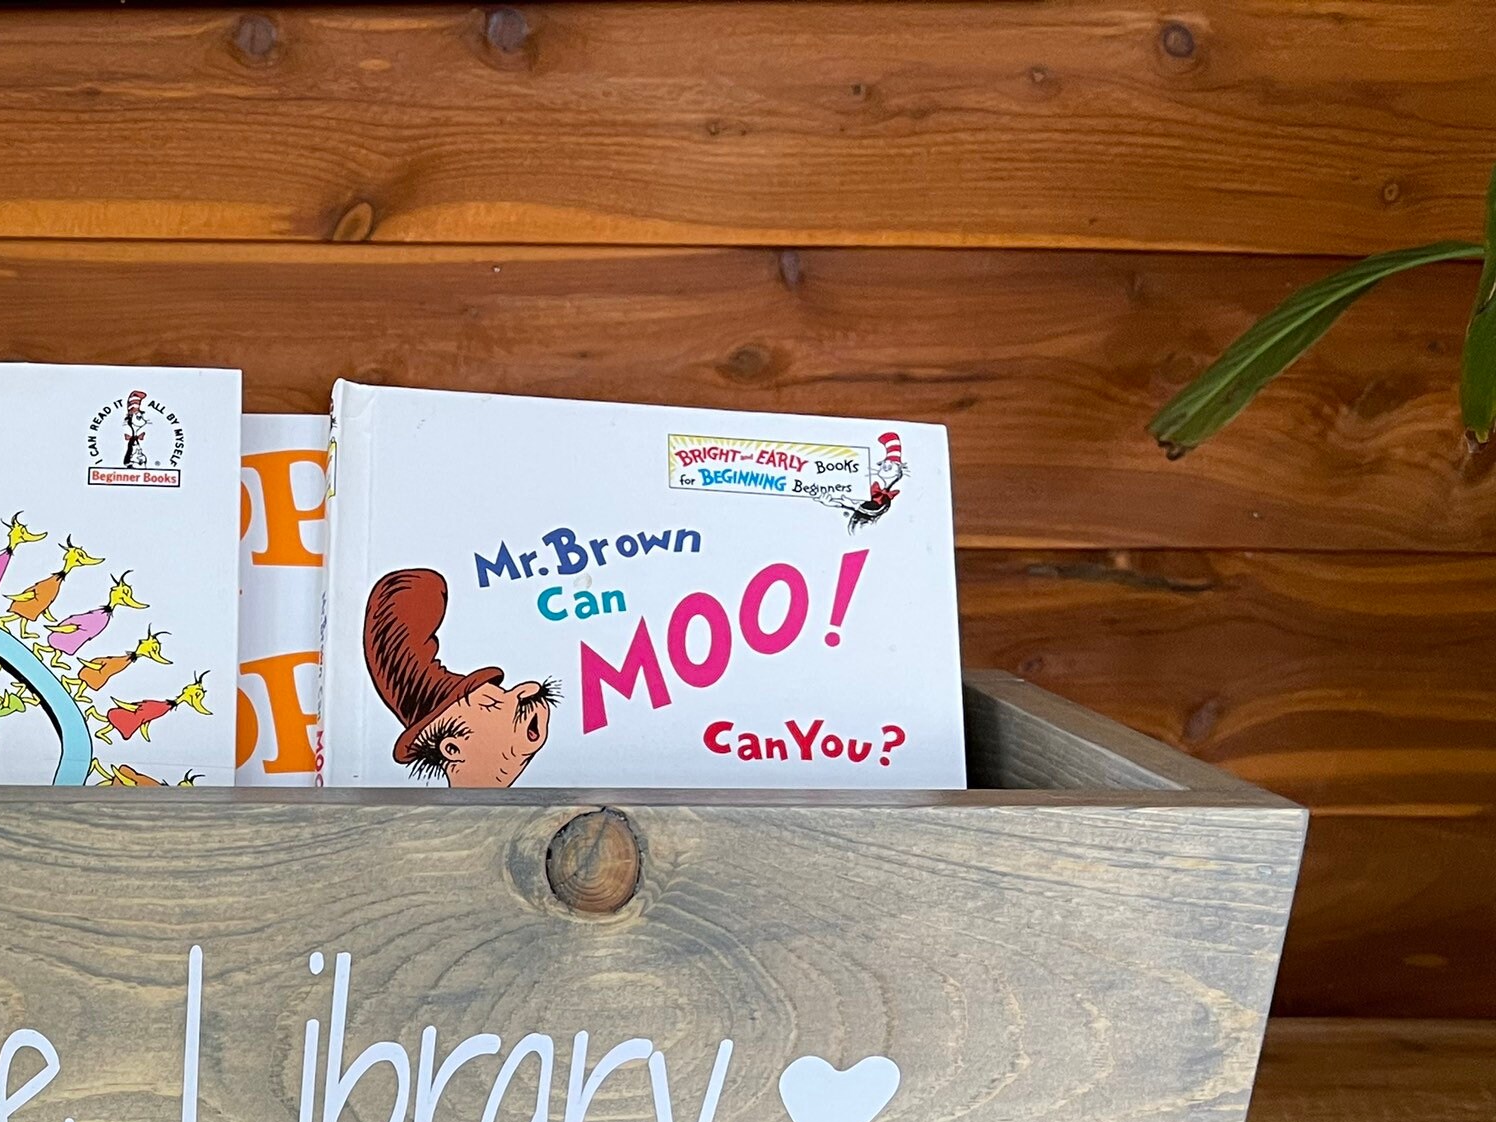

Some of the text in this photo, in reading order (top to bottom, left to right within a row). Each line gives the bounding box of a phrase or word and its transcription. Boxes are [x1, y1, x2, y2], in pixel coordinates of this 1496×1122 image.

[113, 399, 123, 409] IT
[147, 400, 166, 415] ALL
[90, 406, 112, 431] READ
[166, 413, 180, 426] BY
[88, 436, 99, 457] CAN
[169, 428, 185, 468] MYSELF
[675, 446, 741, 467] BRIGHT
[756, 449, 809, 472] EARLY
[814, 459, 860, 474] Books
[91, 470, 177, 484] Beginner Books
[679, 468, 853, 496] for BEGINNING Beginners
[537, 586, 627, 621] Can
[580, 549, 869, 735] MOO!
